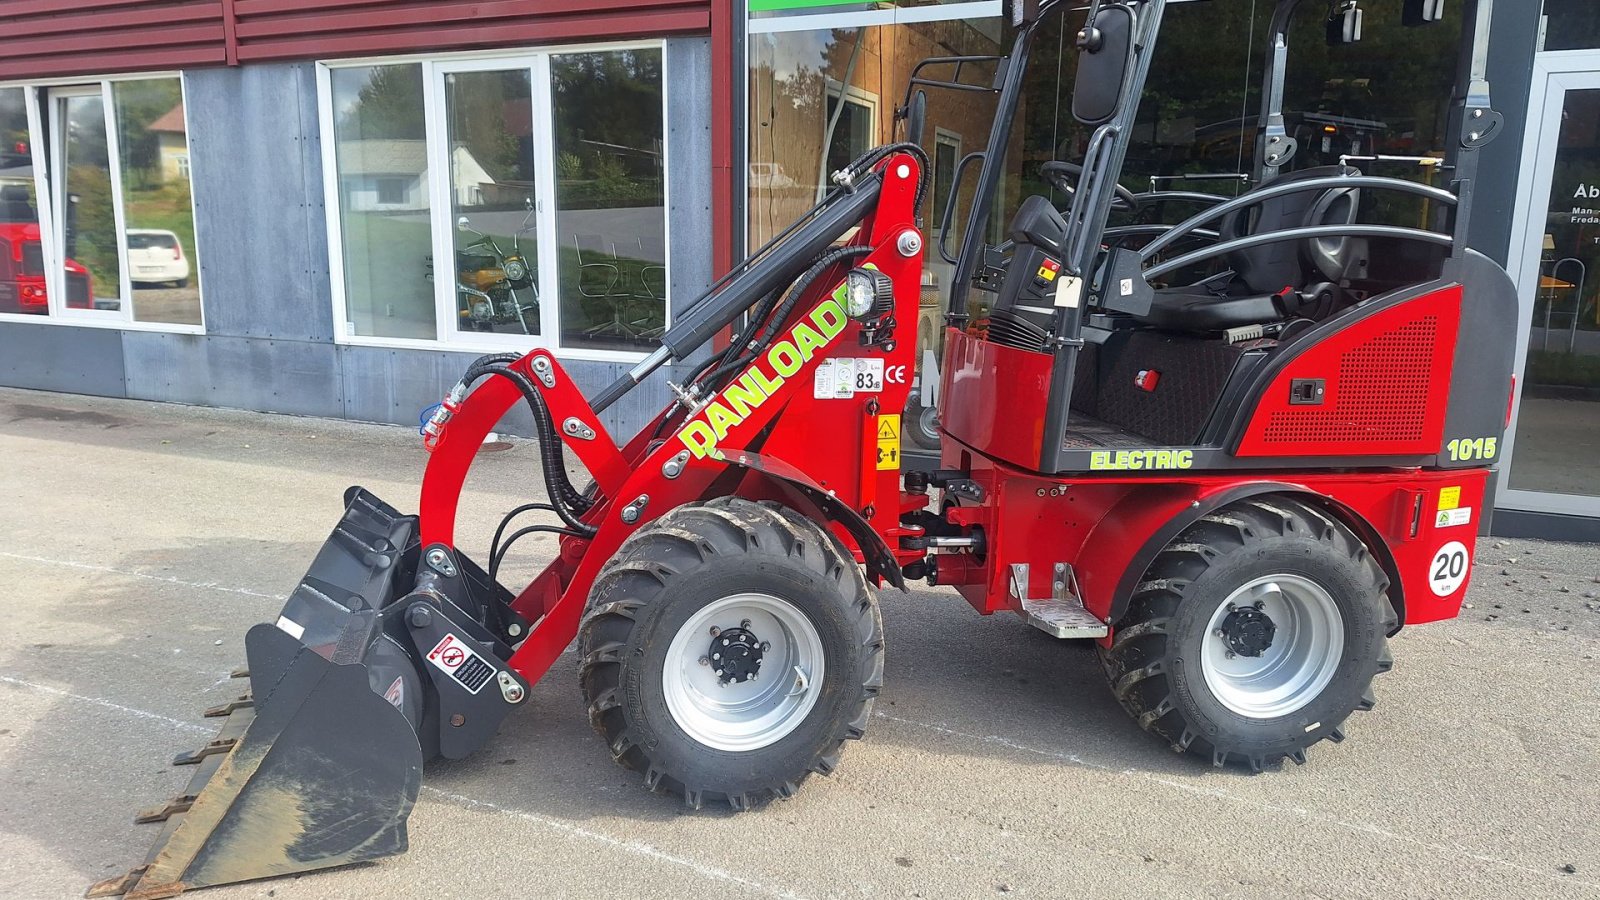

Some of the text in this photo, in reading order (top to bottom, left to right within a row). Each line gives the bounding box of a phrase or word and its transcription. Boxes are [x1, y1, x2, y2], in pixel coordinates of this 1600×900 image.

[1571, 216, 1600, 224] Freda
[678, 263, 878, 460] DANLOAD
[857, 373, 873, 388] 83
[885, 365, 905, 383] CE
[1447, 437, 1497, 461] 1015
[1090, 450, 1193, 470] ELECTRIC
[1434, 551, 1464, 581] 20
